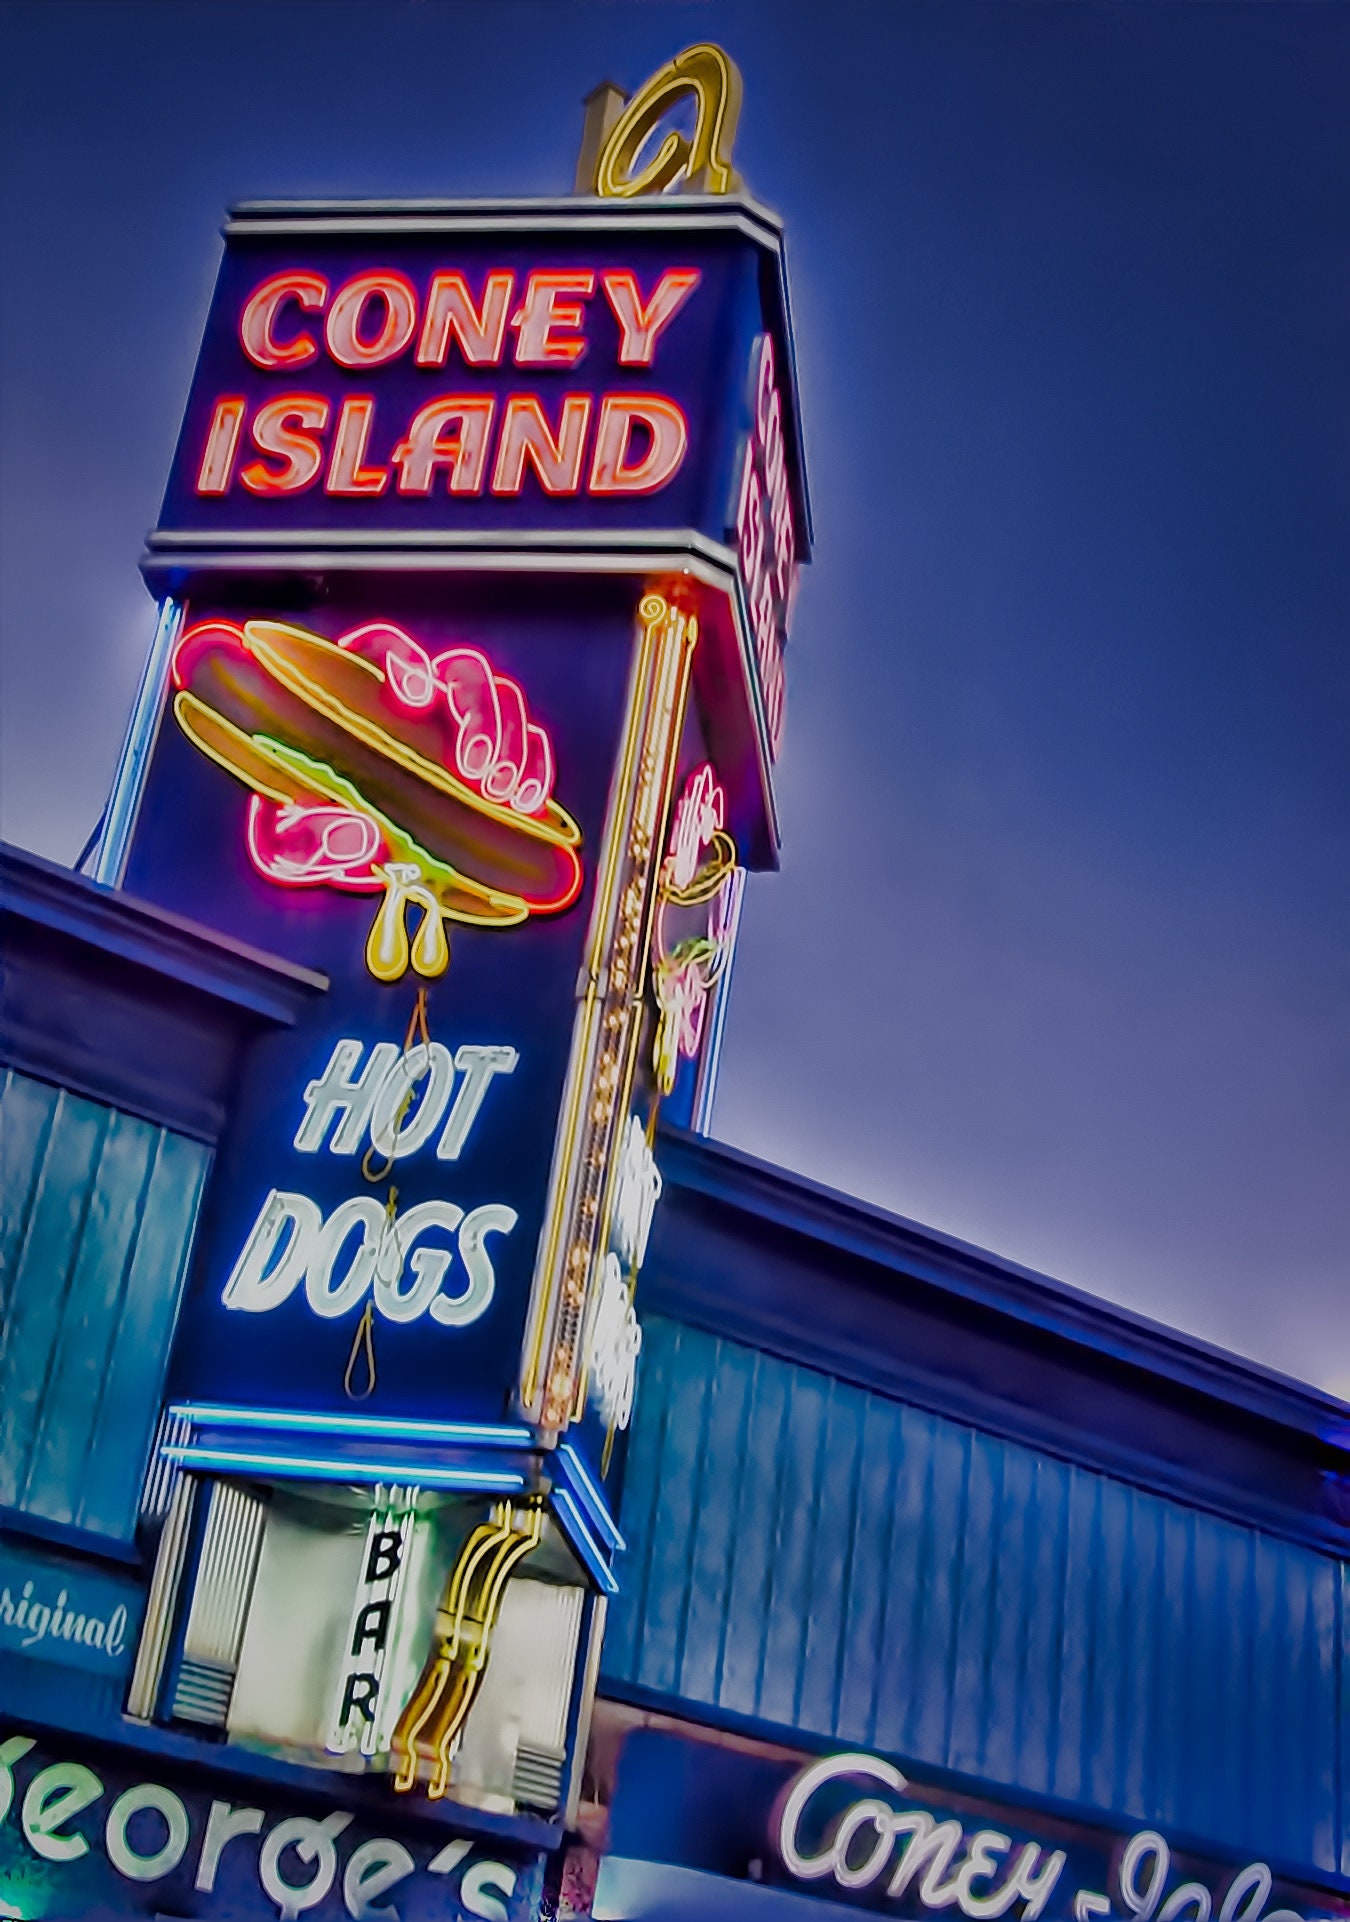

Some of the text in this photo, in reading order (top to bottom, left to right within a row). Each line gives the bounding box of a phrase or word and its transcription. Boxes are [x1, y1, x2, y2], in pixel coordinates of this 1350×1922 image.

[240, 268, 699, 368] CONEY
[194, 392, 688, 497] ISLAND
[294, 1039, 519, 1161] HOT
[221, 1188, 519, 1326] DOGS
[339, 1531, 403, 1727] BAR
[0, 1735, 518, 1922] eorge's
